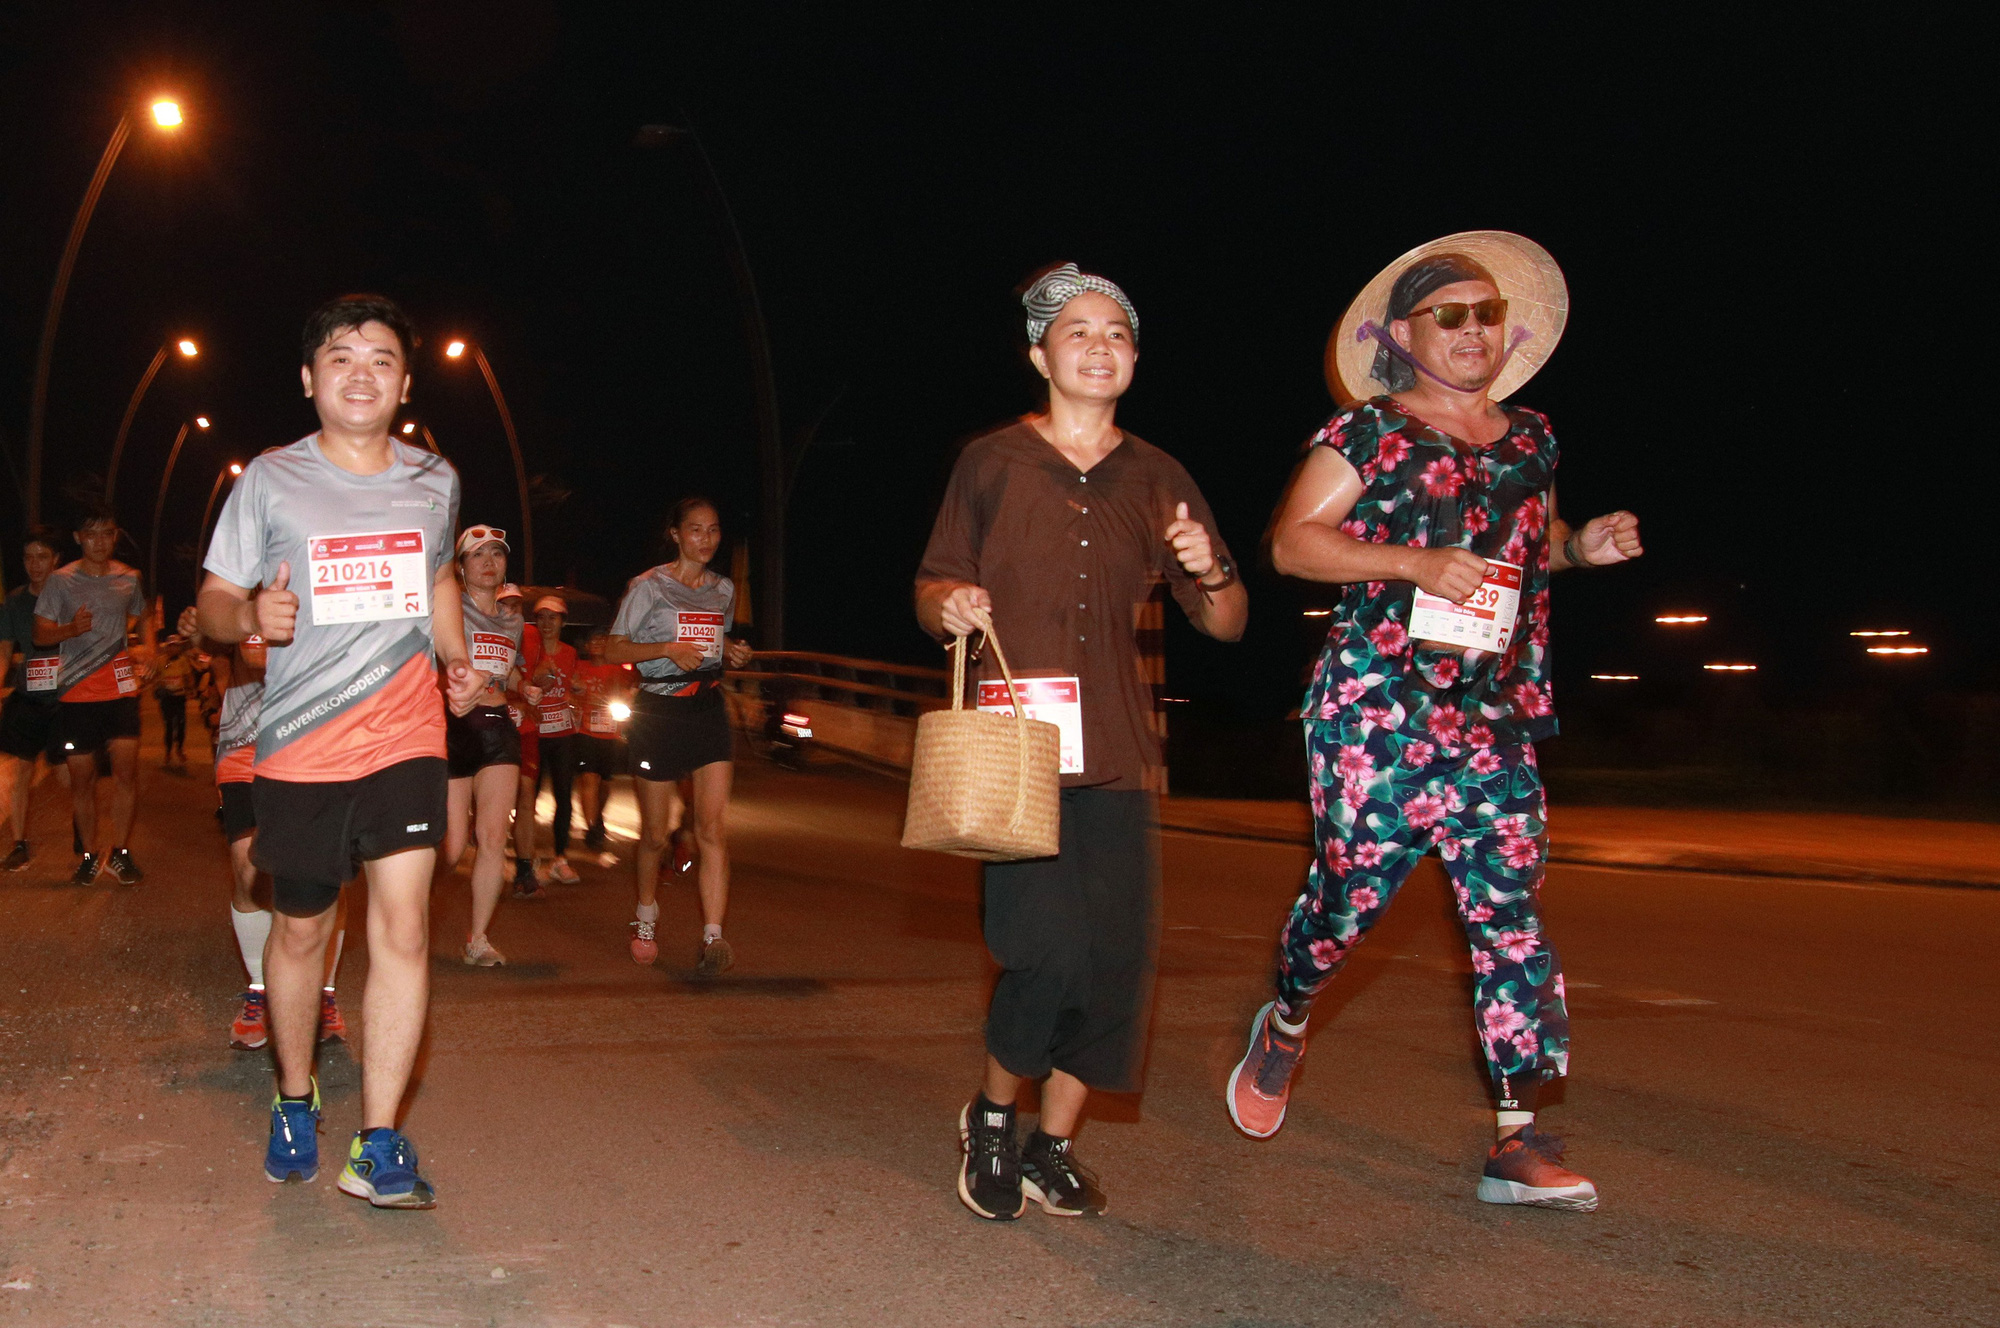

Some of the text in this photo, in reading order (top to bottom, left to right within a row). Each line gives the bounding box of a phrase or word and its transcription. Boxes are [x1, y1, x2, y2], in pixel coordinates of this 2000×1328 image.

[317, 560, 392, 583] 210216
[681, 626, 716, 637] 210420
[476, 644, 509, 657] 210105
[27, 667, 53, 677] 210027
[275, 664, 391, 740] #SAVEMEKONGDELTA
